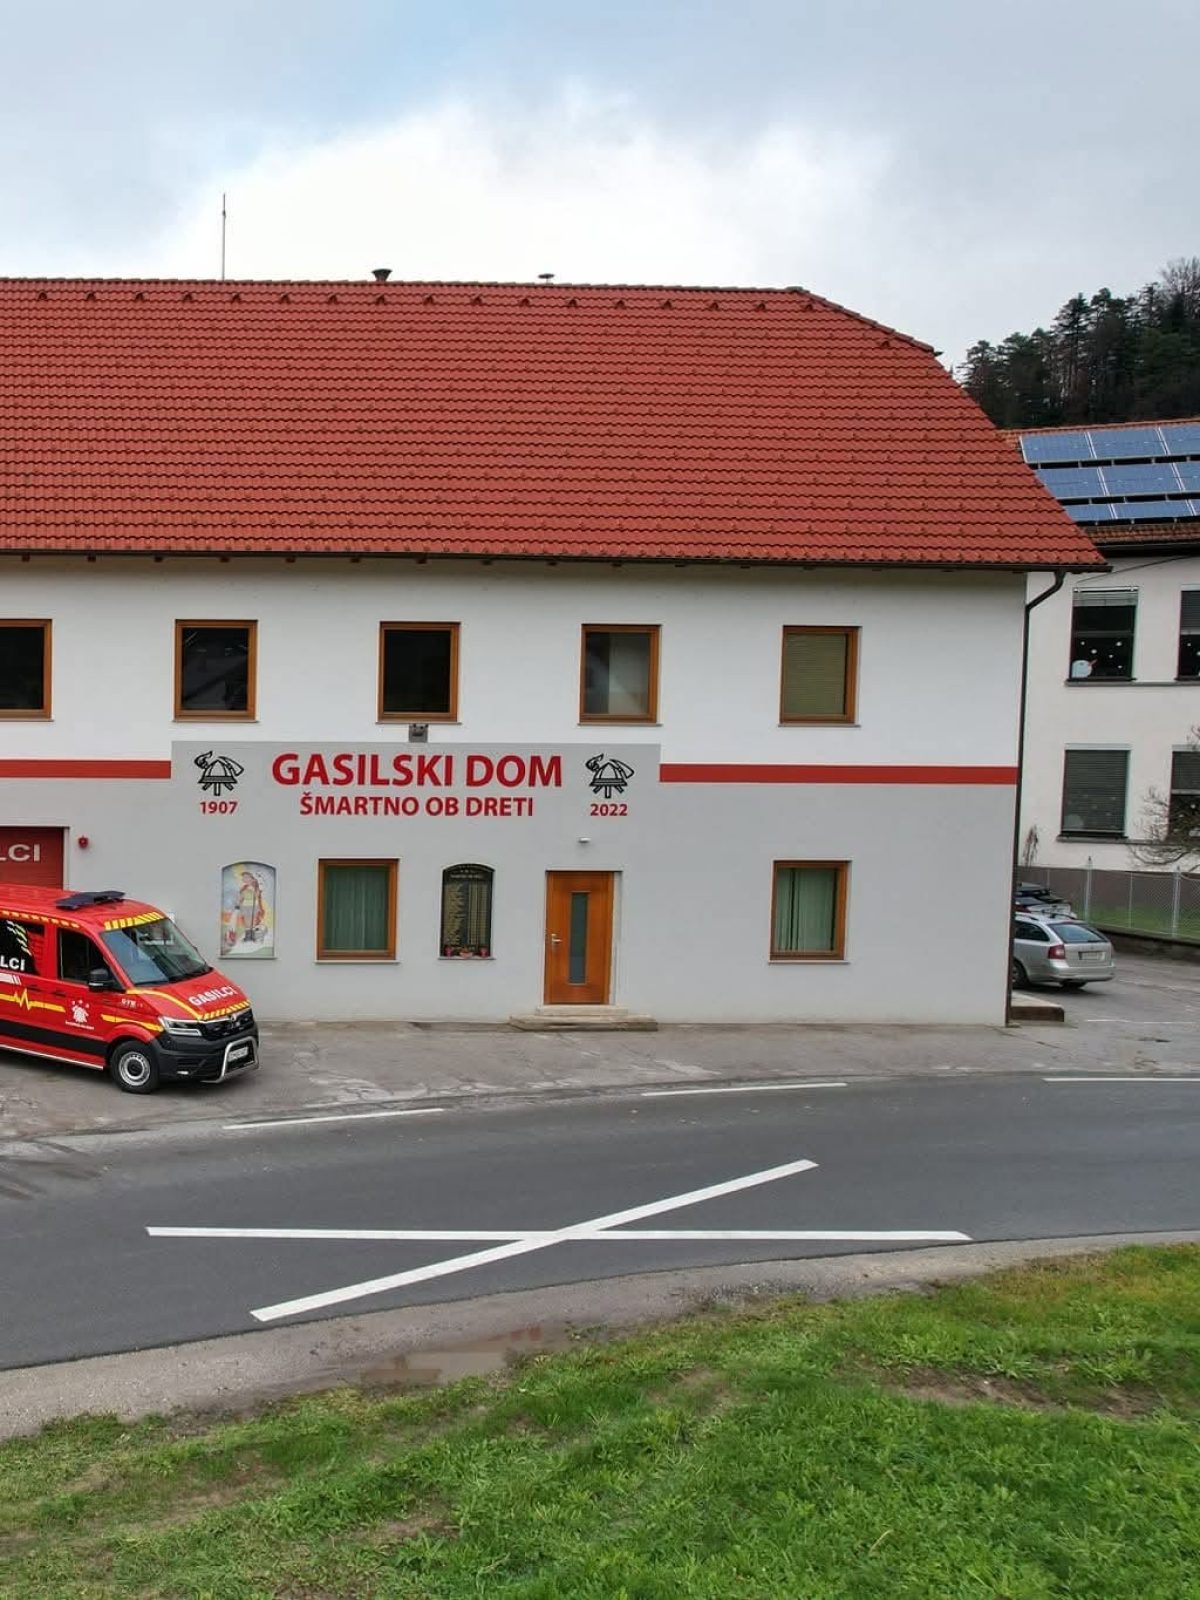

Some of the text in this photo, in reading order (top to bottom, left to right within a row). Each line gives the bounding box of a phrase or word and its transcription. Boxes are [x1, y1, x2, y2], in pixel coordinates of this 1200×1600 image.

[272, 753, 562, 787] GASILSKI DOM
[200, 801, 238, 814] 1907
[300, 792, 533, 817] ŠMARTNO OB DRETI
[589, 803, 628, 816] 2022
[188, 986, 238, 1006] GASILCI
